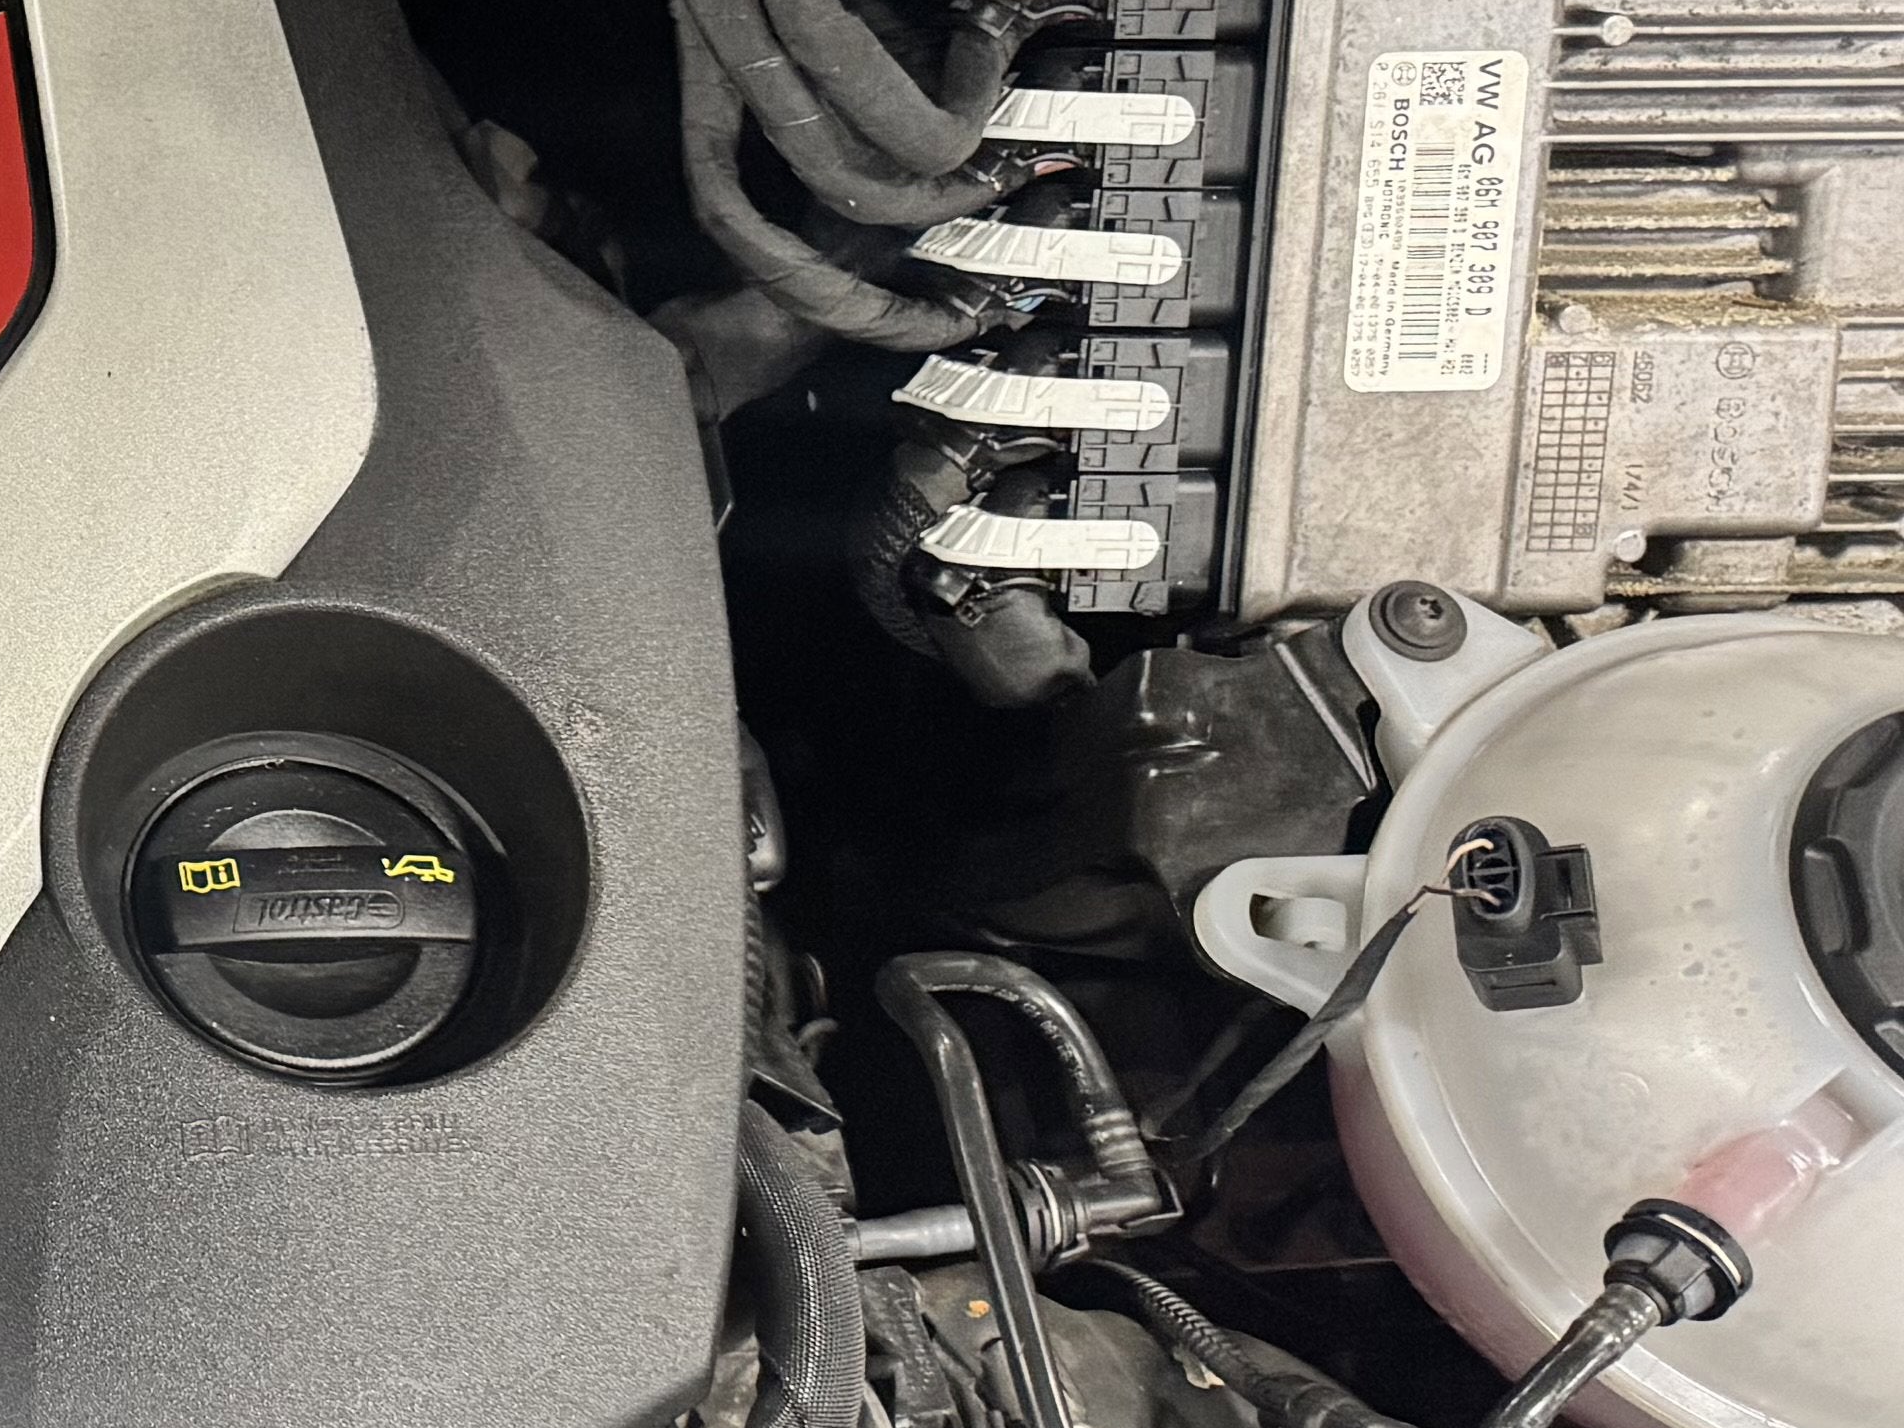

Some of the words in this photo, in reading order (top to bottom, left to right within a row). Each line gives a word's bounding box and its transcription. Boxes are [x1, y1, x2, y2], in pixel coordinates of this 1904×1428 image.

[1371, 81, 1386, 108] 261
[1476, 57, 1502, 110] VW
[1388, 97, 1410, 171] BOSCH
[1471, 120, 1496, 165] AG
[1365, 159, 1380, 188] 655
[1378, 179, 1393, 240] MOTRONIC
[1473, 176, 1502, 209] 06M
[1470, 219, 1498, 251] 907
[1386, 260, 1399, 295] Made
[1466, 262, 1495, 294] 309
[1385, 300, 1395, 312] in
[1464, 307, 1491, 316] D
[1378, 317, 1394, 376] Germany
[256, 894, 366, 929] Castrol
